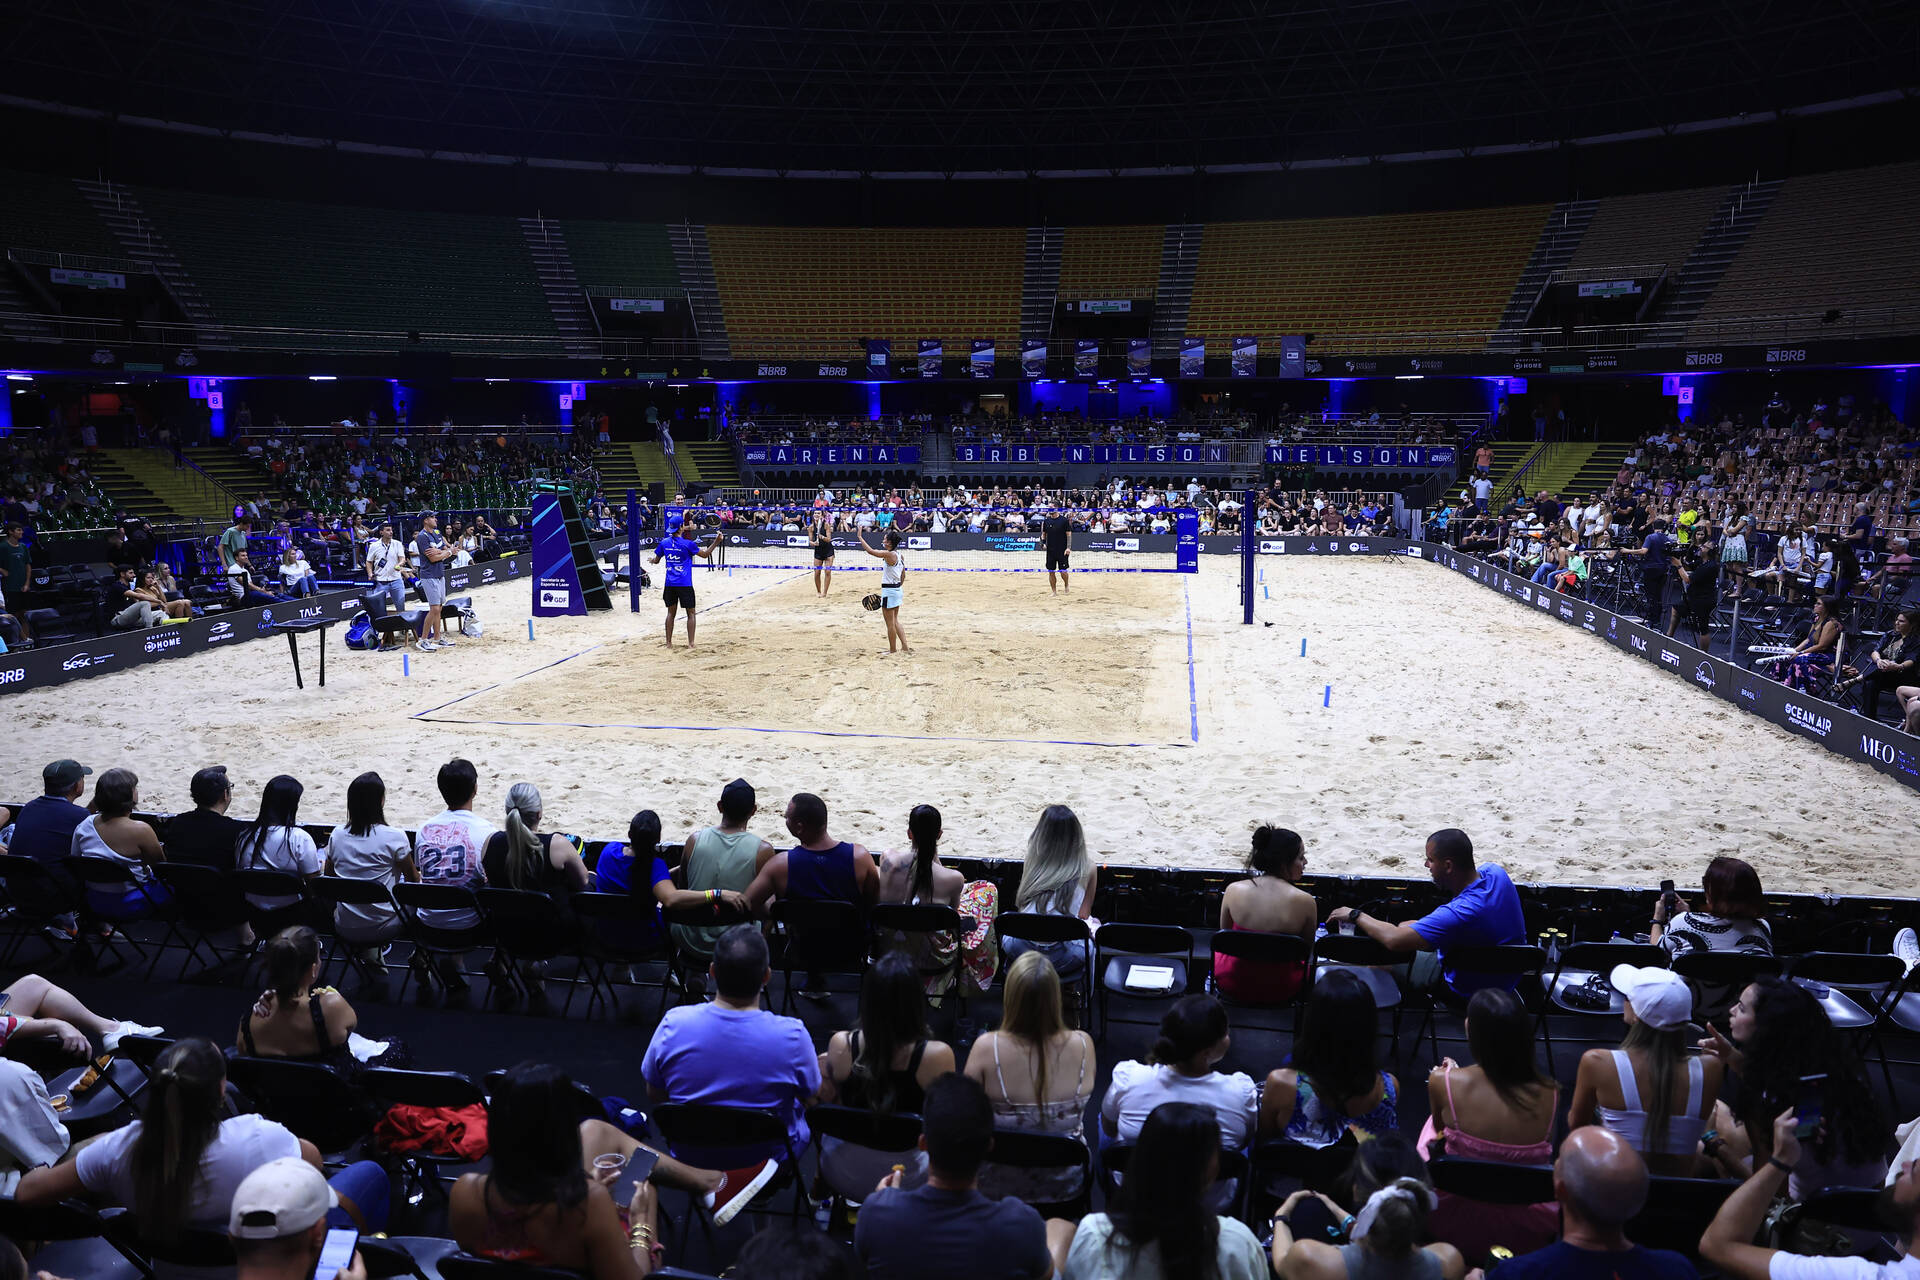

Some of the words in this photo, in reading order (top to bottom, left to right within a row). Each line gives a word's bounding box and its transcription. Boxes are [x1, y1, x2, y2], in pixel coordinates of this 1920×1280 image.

[1698, 353, 1724, 365] BRB
[1780, 349, 1806, 362] BRB
[767, 366, 788, 376] BRB
[828, 366, 848, 376] BRB
[777, 448, 888, 463] ARENA
[965, 448, 1027, 463] BRB
[1073, 448, 1221, 462] NILSON
[1272, 448, 1418, 464] NELSON
[299, 606, 323, 618] TALK
[146, 630, 180, 641] HOSPITAL
[157, 637, 181, 649] HOME
[1631, 634, 1648, 652] TALK
[1661, 648, 1680, 667] ESPN
[1784, 702, 1816, 726] OCEAN
[1815, 715, 1832, 733] AIR
[1859, 734, 1895, 764] MEO
[422, 844, 466, 878] 23
